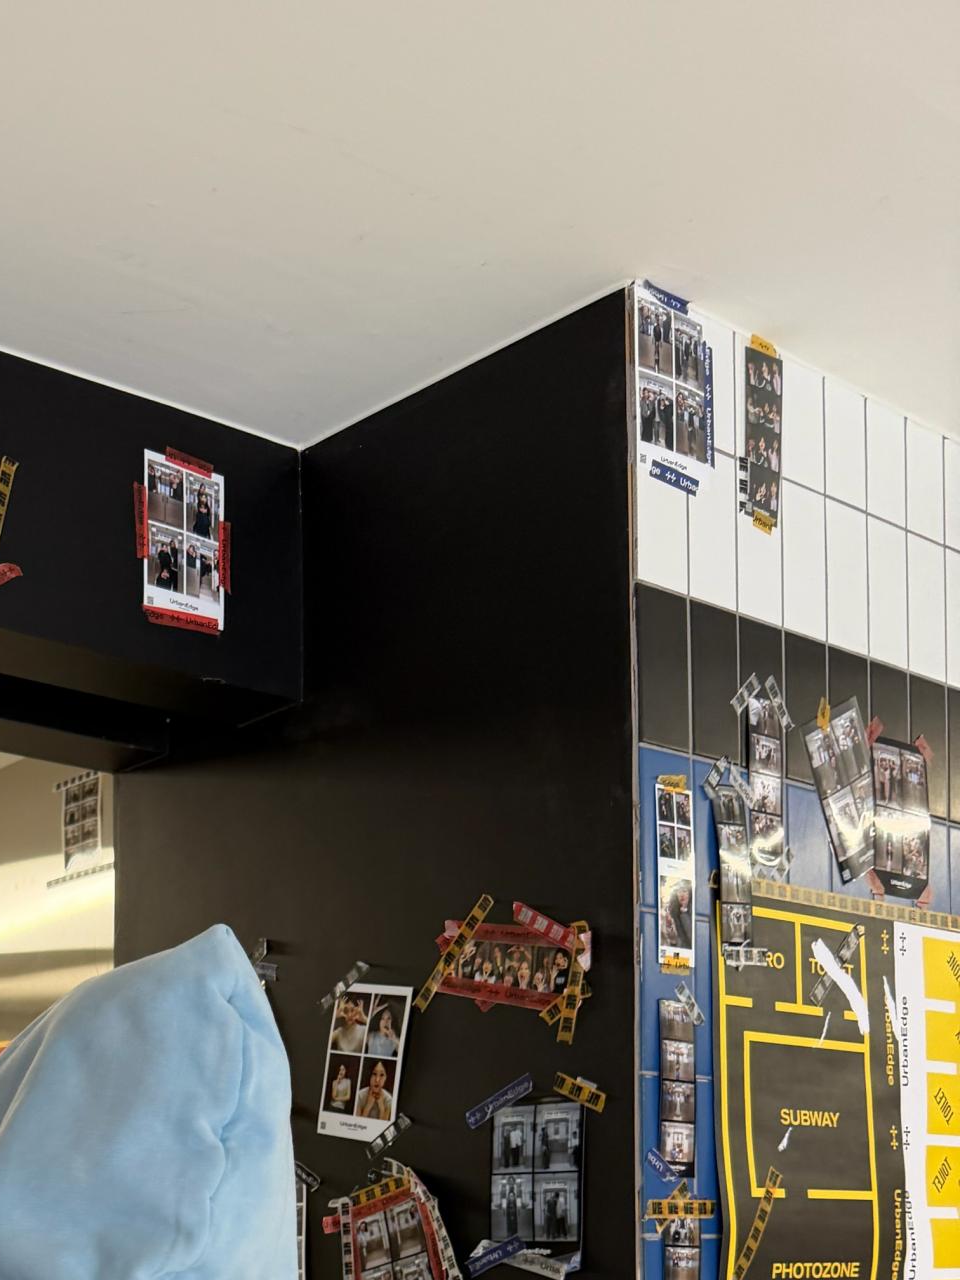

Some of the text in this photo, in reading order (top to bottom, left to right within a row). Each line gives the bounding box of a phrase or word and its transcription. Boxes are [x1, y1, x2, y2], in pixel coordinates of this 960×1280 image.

[781, 1109, 839, 1127] SUBWAY
[901, 996, 916, 1280] UrbanEdge UrbanEdge
[772, 1262, 860, 1279] PHOTOZONE
